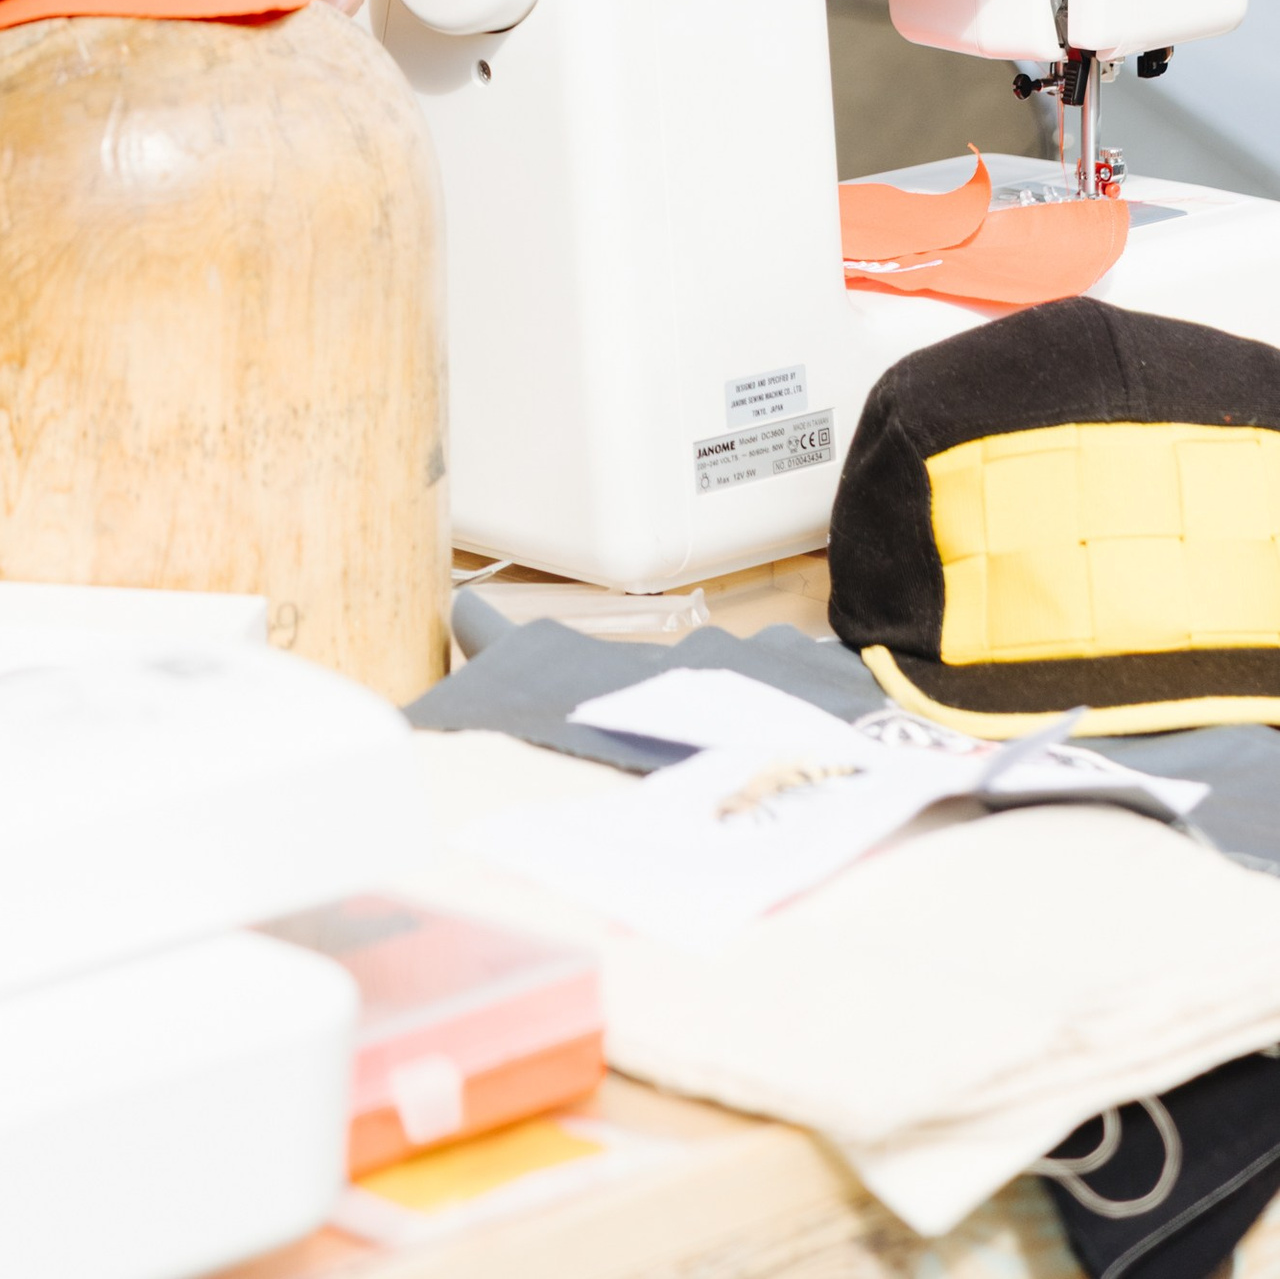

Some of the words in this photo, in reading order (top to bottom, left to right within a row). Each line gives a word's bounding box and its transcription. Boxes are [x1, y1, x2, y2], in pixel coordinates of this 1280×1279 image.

[696, 440, 736, 459] JANOME
[739, 434, 758, 446] Model
[761, 428, 785, 441] DC3600
[787, 453, 823, 468] 010043434
